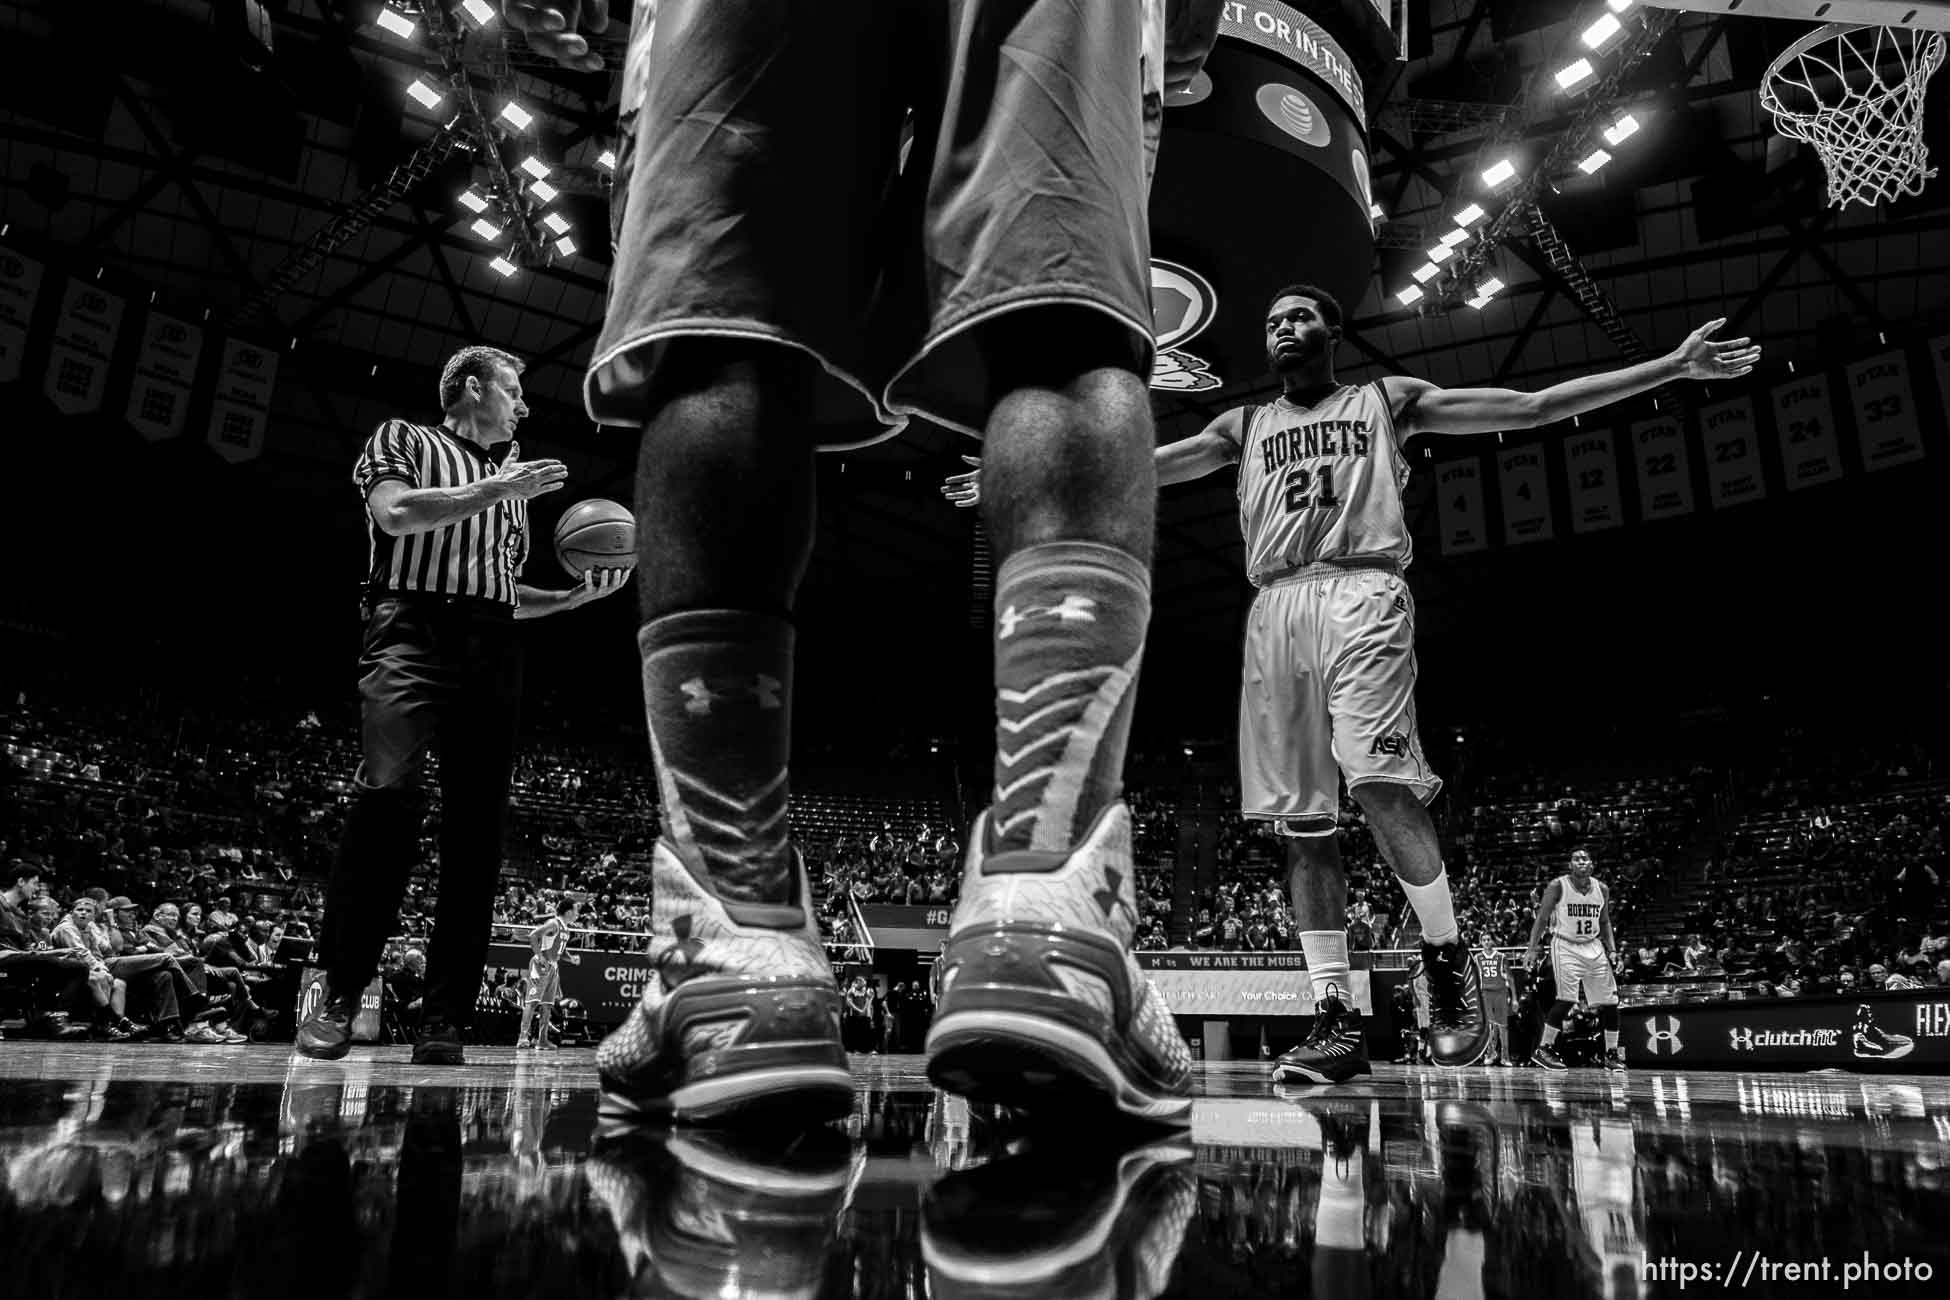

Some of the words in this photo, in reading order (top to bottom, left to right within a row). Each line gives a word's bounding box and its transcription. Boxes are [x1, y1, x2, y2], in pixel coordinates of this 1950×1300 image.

[1253, 11, 1291, 44] OR
[1295, 29, 1319, 60] IN
[1321, 46, 1353, 94] THE
[1863, 394, 1903, 423] 33
[1788, 417, 1823, 444] 24
[1262, 420, 1373, 476] HORNETS
[1714, 437, 1747, 464] 23
[1644, 452, 1679, 478] 22
[1284, 464, 1338, 513] 21
[1579, 468, 1605, 490] 12
[1567, 903, 1601, 918] HORNETS
[1576, 919, 1592, 935] 12
[1189, 956, 1211, 967] WE
[1214, 956, 1239, 967] ARE
[1241, 956, 1265, 967] THE
[1267, 956, 1302, 967] MUSS
[1482, 966, 1499, 978] 35
[361, 994, 380, 1009] CLUB
[1241, 992, 1263, 1001] Your
